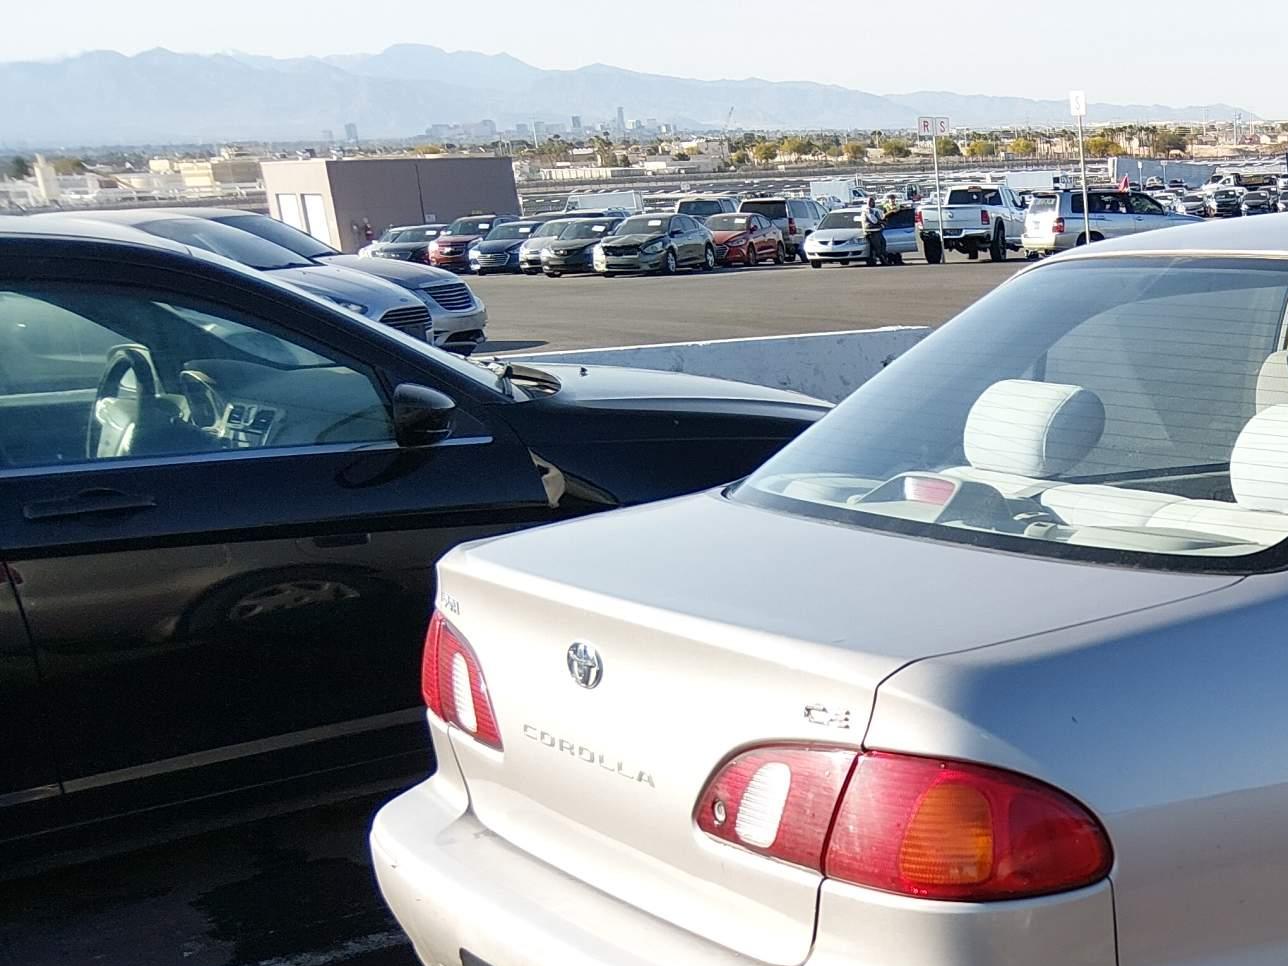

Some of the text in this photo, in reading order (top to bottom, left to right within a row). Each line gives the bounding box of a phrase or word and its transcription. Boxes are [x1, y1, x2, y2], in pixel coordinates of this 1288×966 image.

[923, 120, 930, 133] R
[939, 120, 946, 133] S
[523, 723, 656, 788] COROLLA
